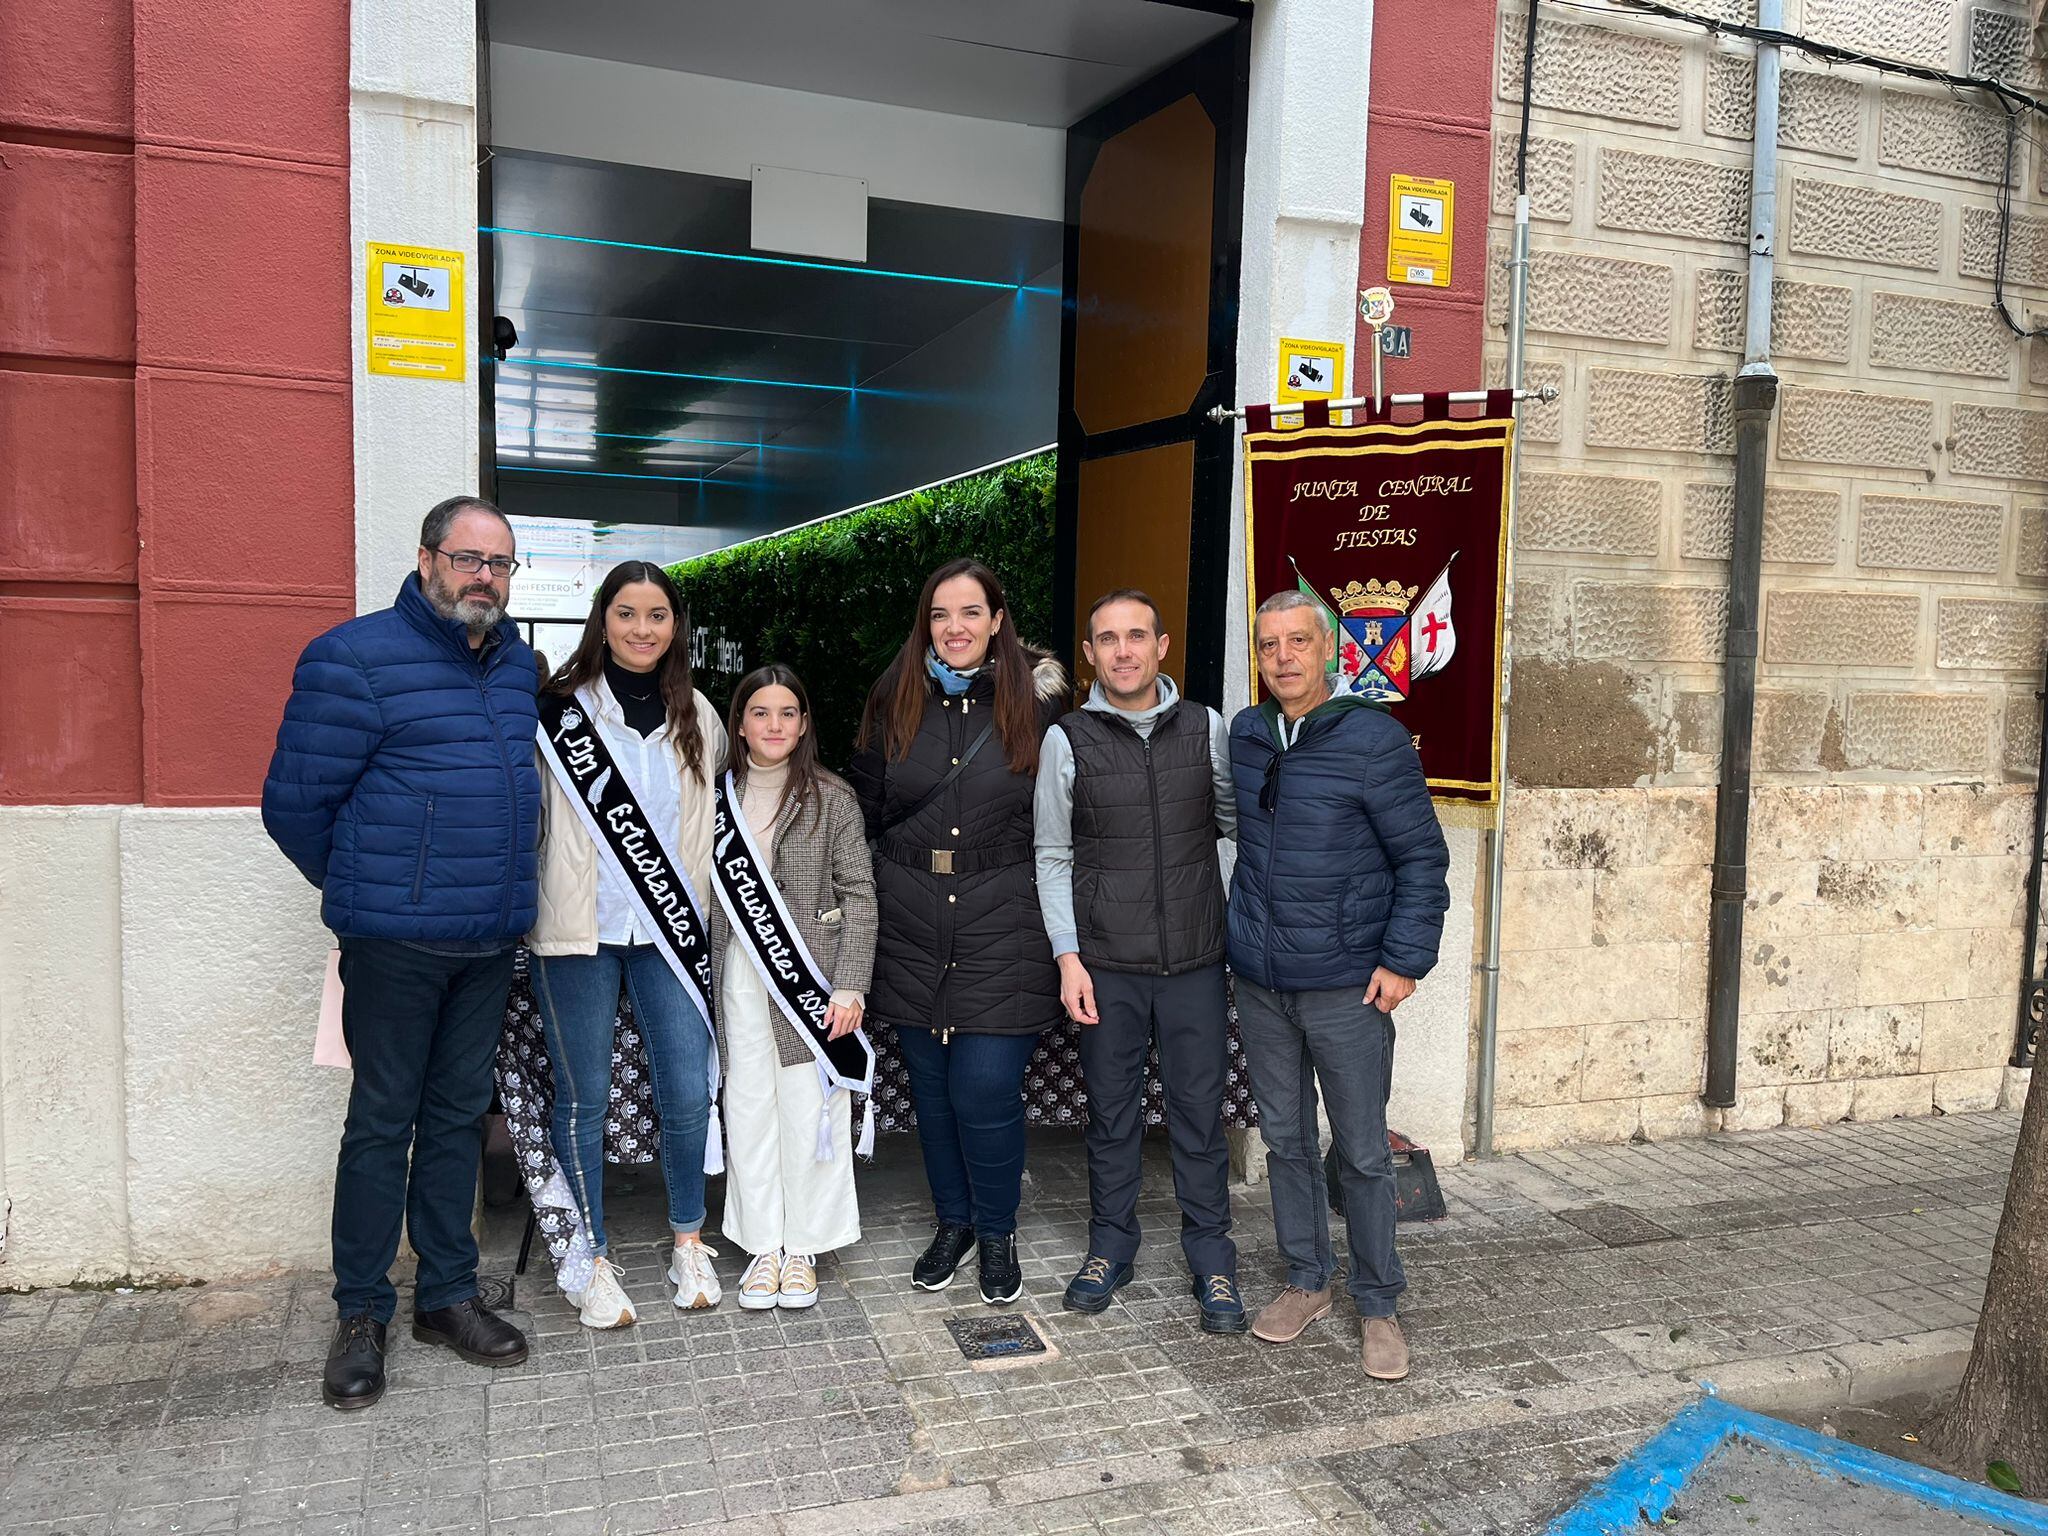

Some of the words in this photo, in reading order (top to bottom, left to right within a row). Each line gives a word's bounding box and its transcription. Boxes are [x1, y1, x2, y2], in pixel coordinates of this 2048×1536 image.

[1397, 184, 1411, 192] ZONA
[1412, 186, 1448, 196] VIDEOVIGILADA
[375, 248, 397, 256] ZONA
[398, 250, 456, 262] VIDEOVIGILADA
[1300, 344, 1339, 353] VIDEOVIGILADA
[1290, 479, 1359, 502] JUNTA
[1378, 475, 1473, 498] CENTRAL
[1358, 504, 1390, 522] DE
[1333, 528, 1417, 551] FIESTAS
[530, 583, 570, 592] FESTERO
[606, 802, 696, 948] Estudiantes
[725, 856, 800, 984] Estudiantes
